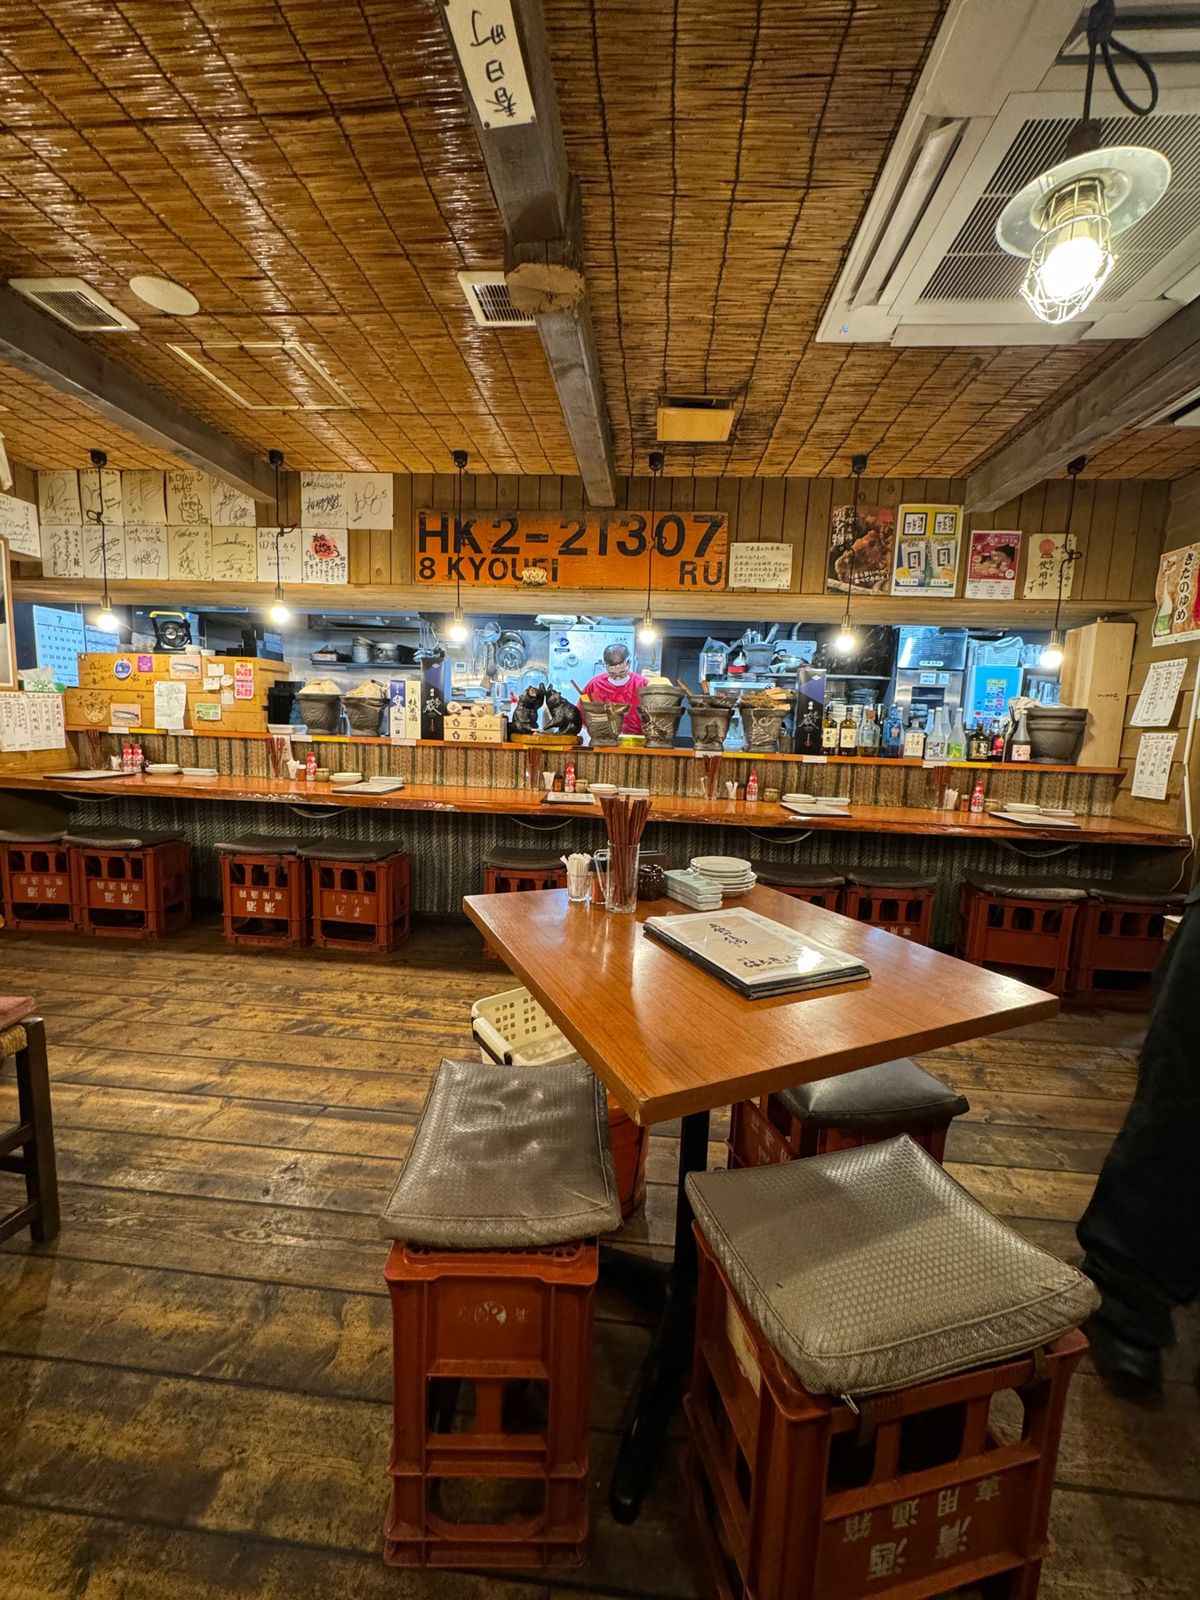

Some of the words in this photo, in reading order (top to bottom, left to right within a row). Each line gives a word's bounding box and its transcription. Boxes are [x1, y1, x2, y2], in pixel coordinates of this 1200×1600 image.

[418, 511, 726, 558] HK2-21307
[419, 558, 436, 580] 8
[679, 560, 723, 586] RU
[1176, 552, 1196, 620] きたのゆめ
[104, 892, 133, 904] 清酒
[246, 900, 276, 914] 清酒
[867, 1515, 972, 1581] 清酒
